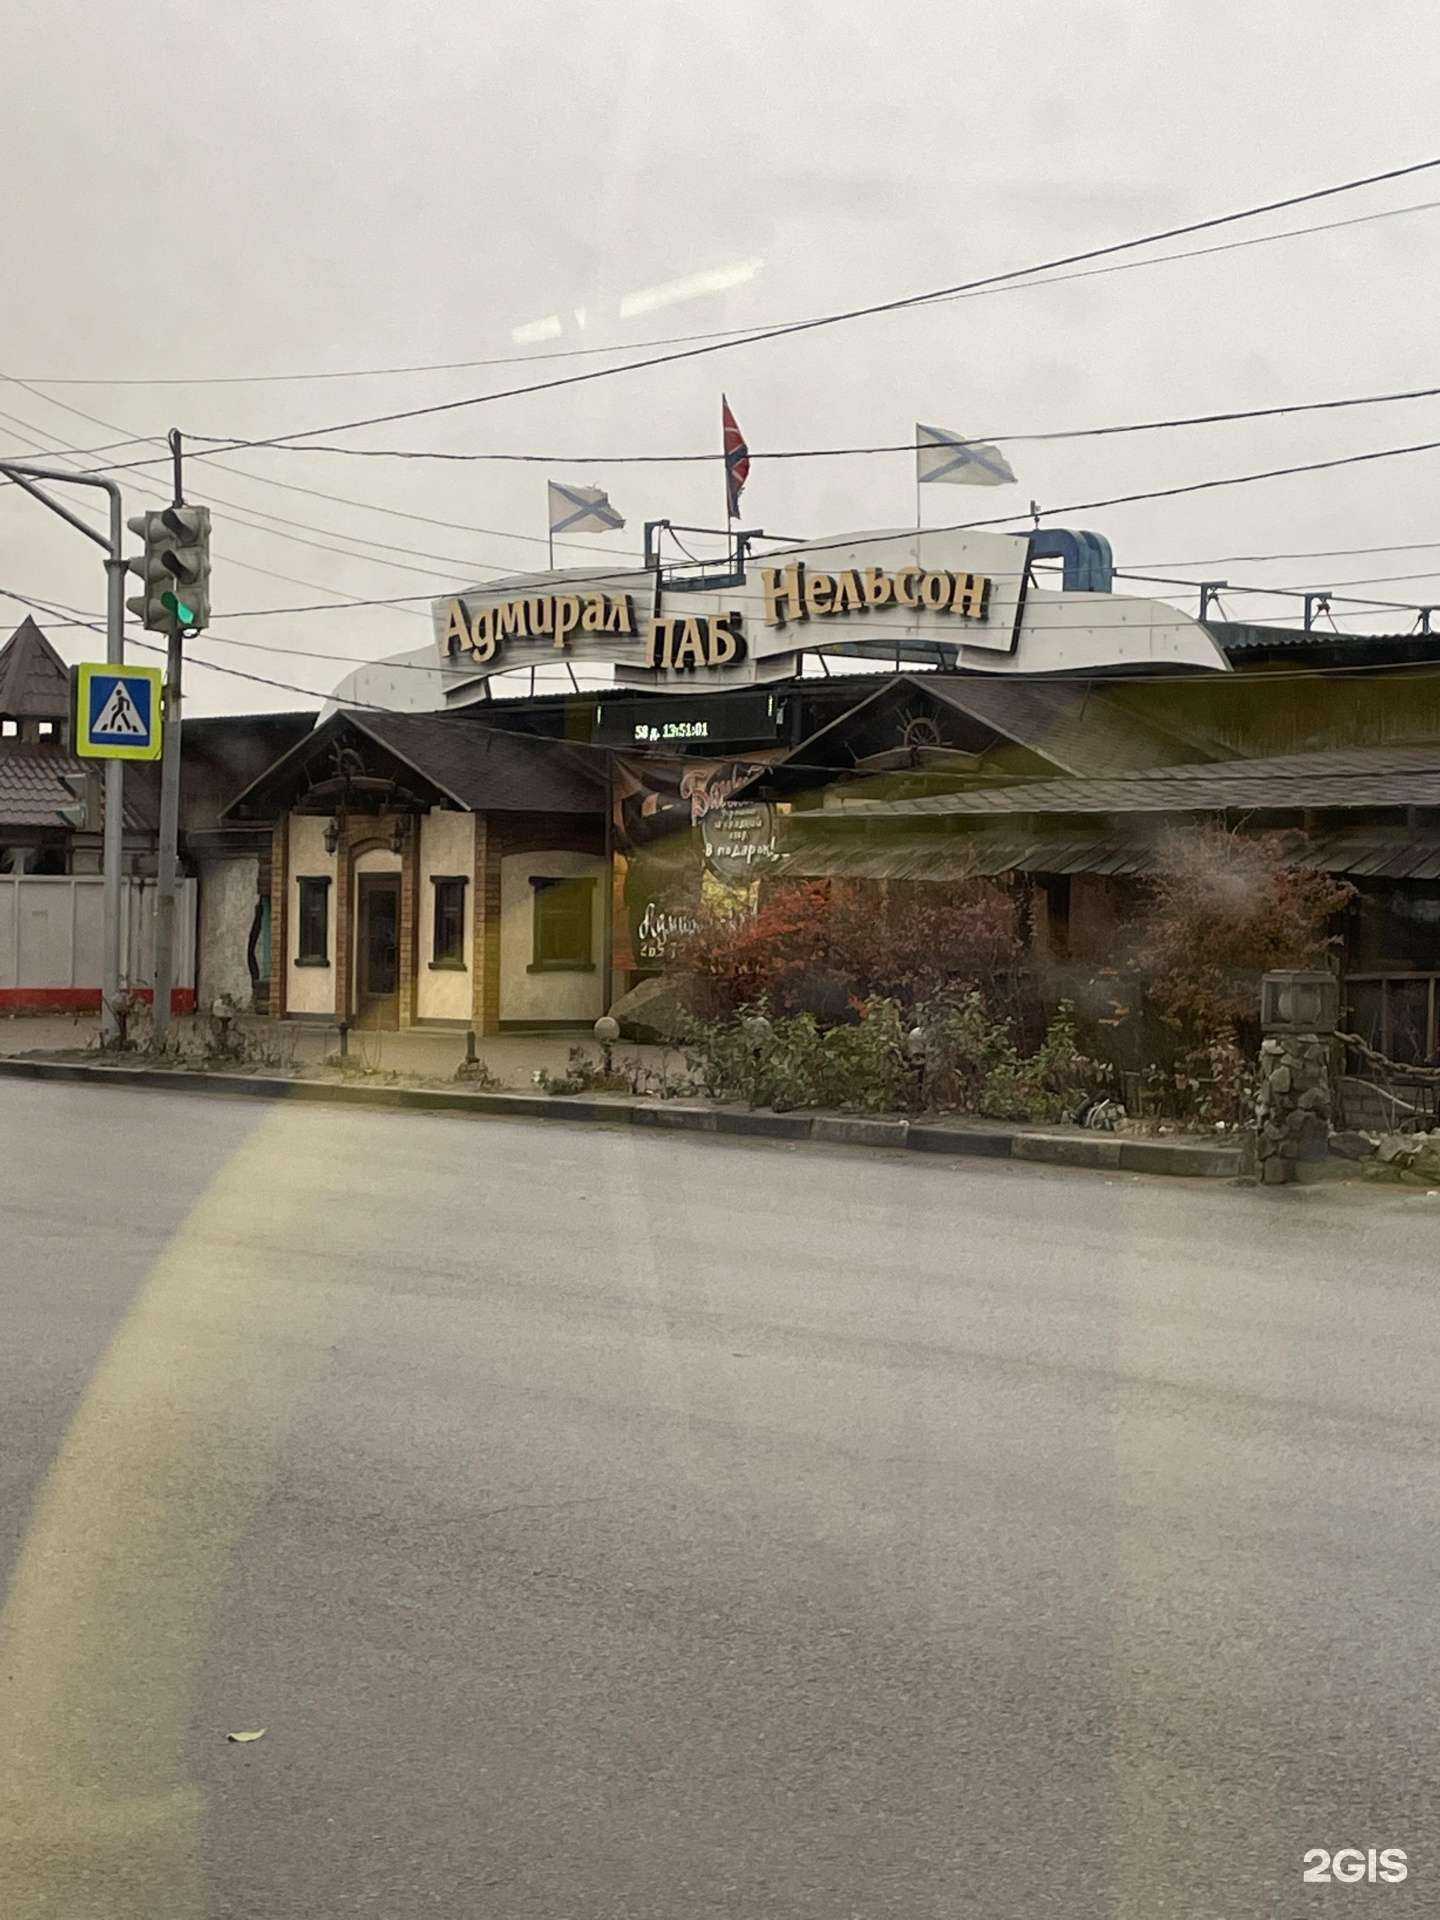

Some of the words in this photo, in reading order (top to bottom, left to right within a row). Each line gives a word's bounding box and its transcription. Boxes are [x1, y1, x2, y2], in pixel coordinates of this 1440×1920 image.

[441, 591, 633, 665] Адмирал
[645, 611, 747, 670] ПАБ
[760, 561, 992, 627] Нельсон
